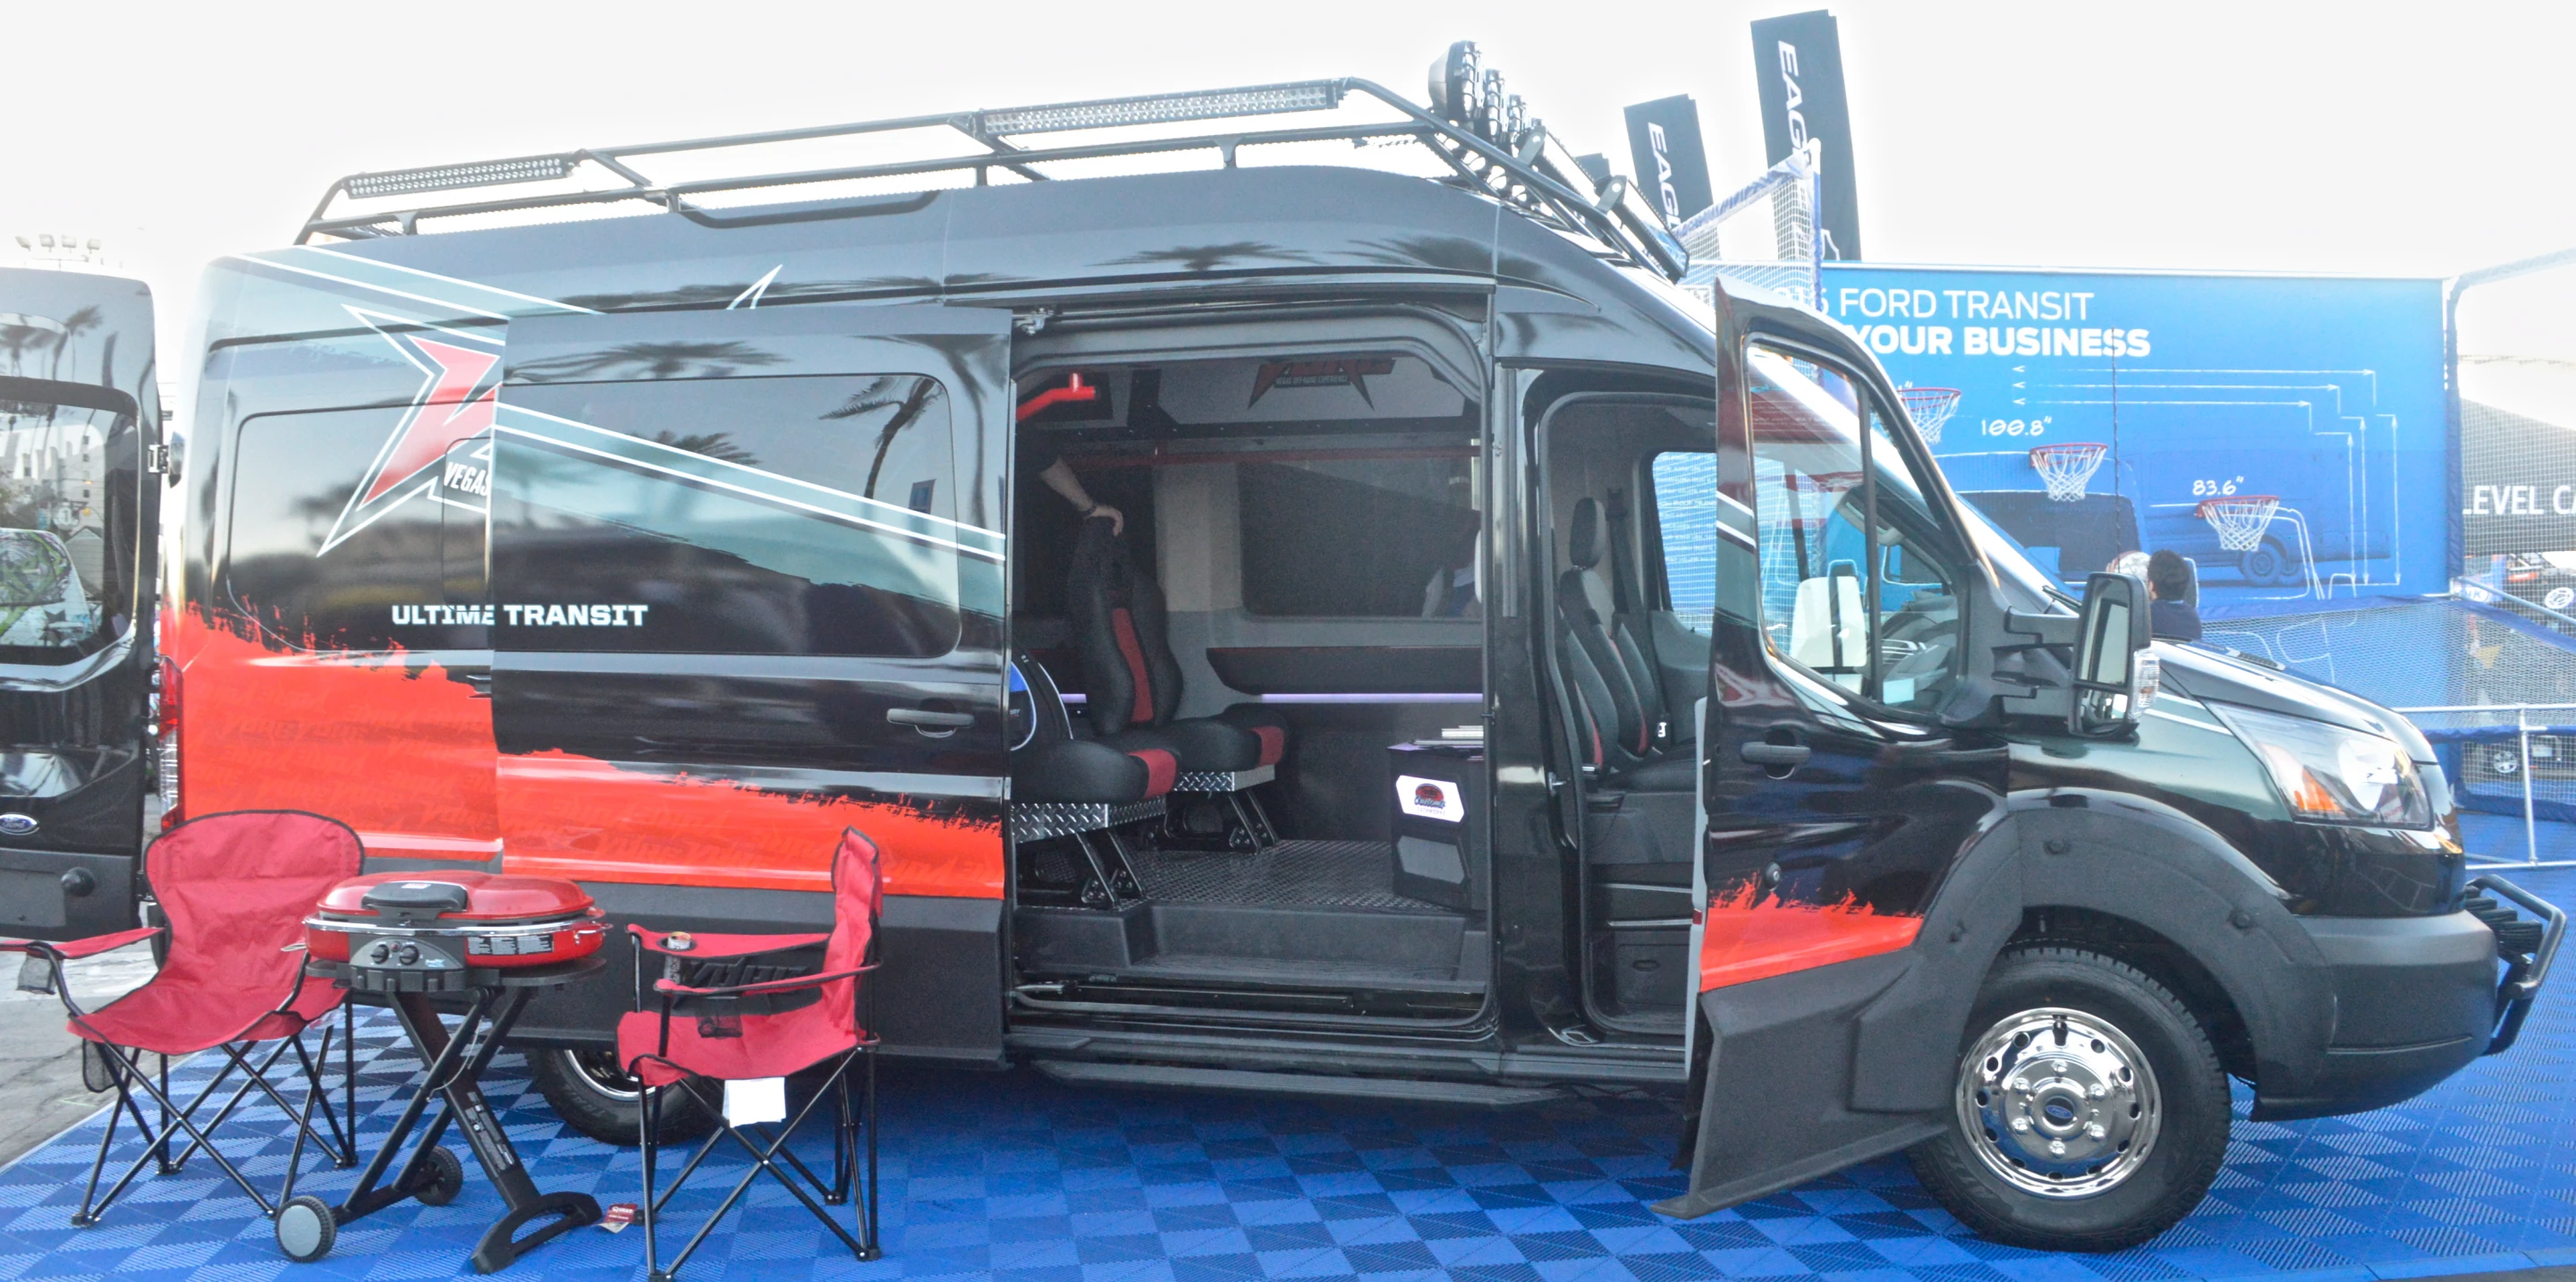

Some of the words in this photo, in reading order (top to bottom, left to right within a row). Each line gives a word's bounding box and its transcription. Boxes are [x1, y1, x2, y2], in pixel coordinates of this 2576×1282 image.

[1840, 288, 1937, 318] FORD
[1944, 290, 2095, 320] TRANSIT
[1850, 325, 1953, 355] YOUR
[1964, 327, 2151, 357] BUSINESS
[2192, 475, 2244, 496] 83.6"
[2462, 485, 2544, 515] EVEL
[503, 605, 648, 626] TRANSIT
